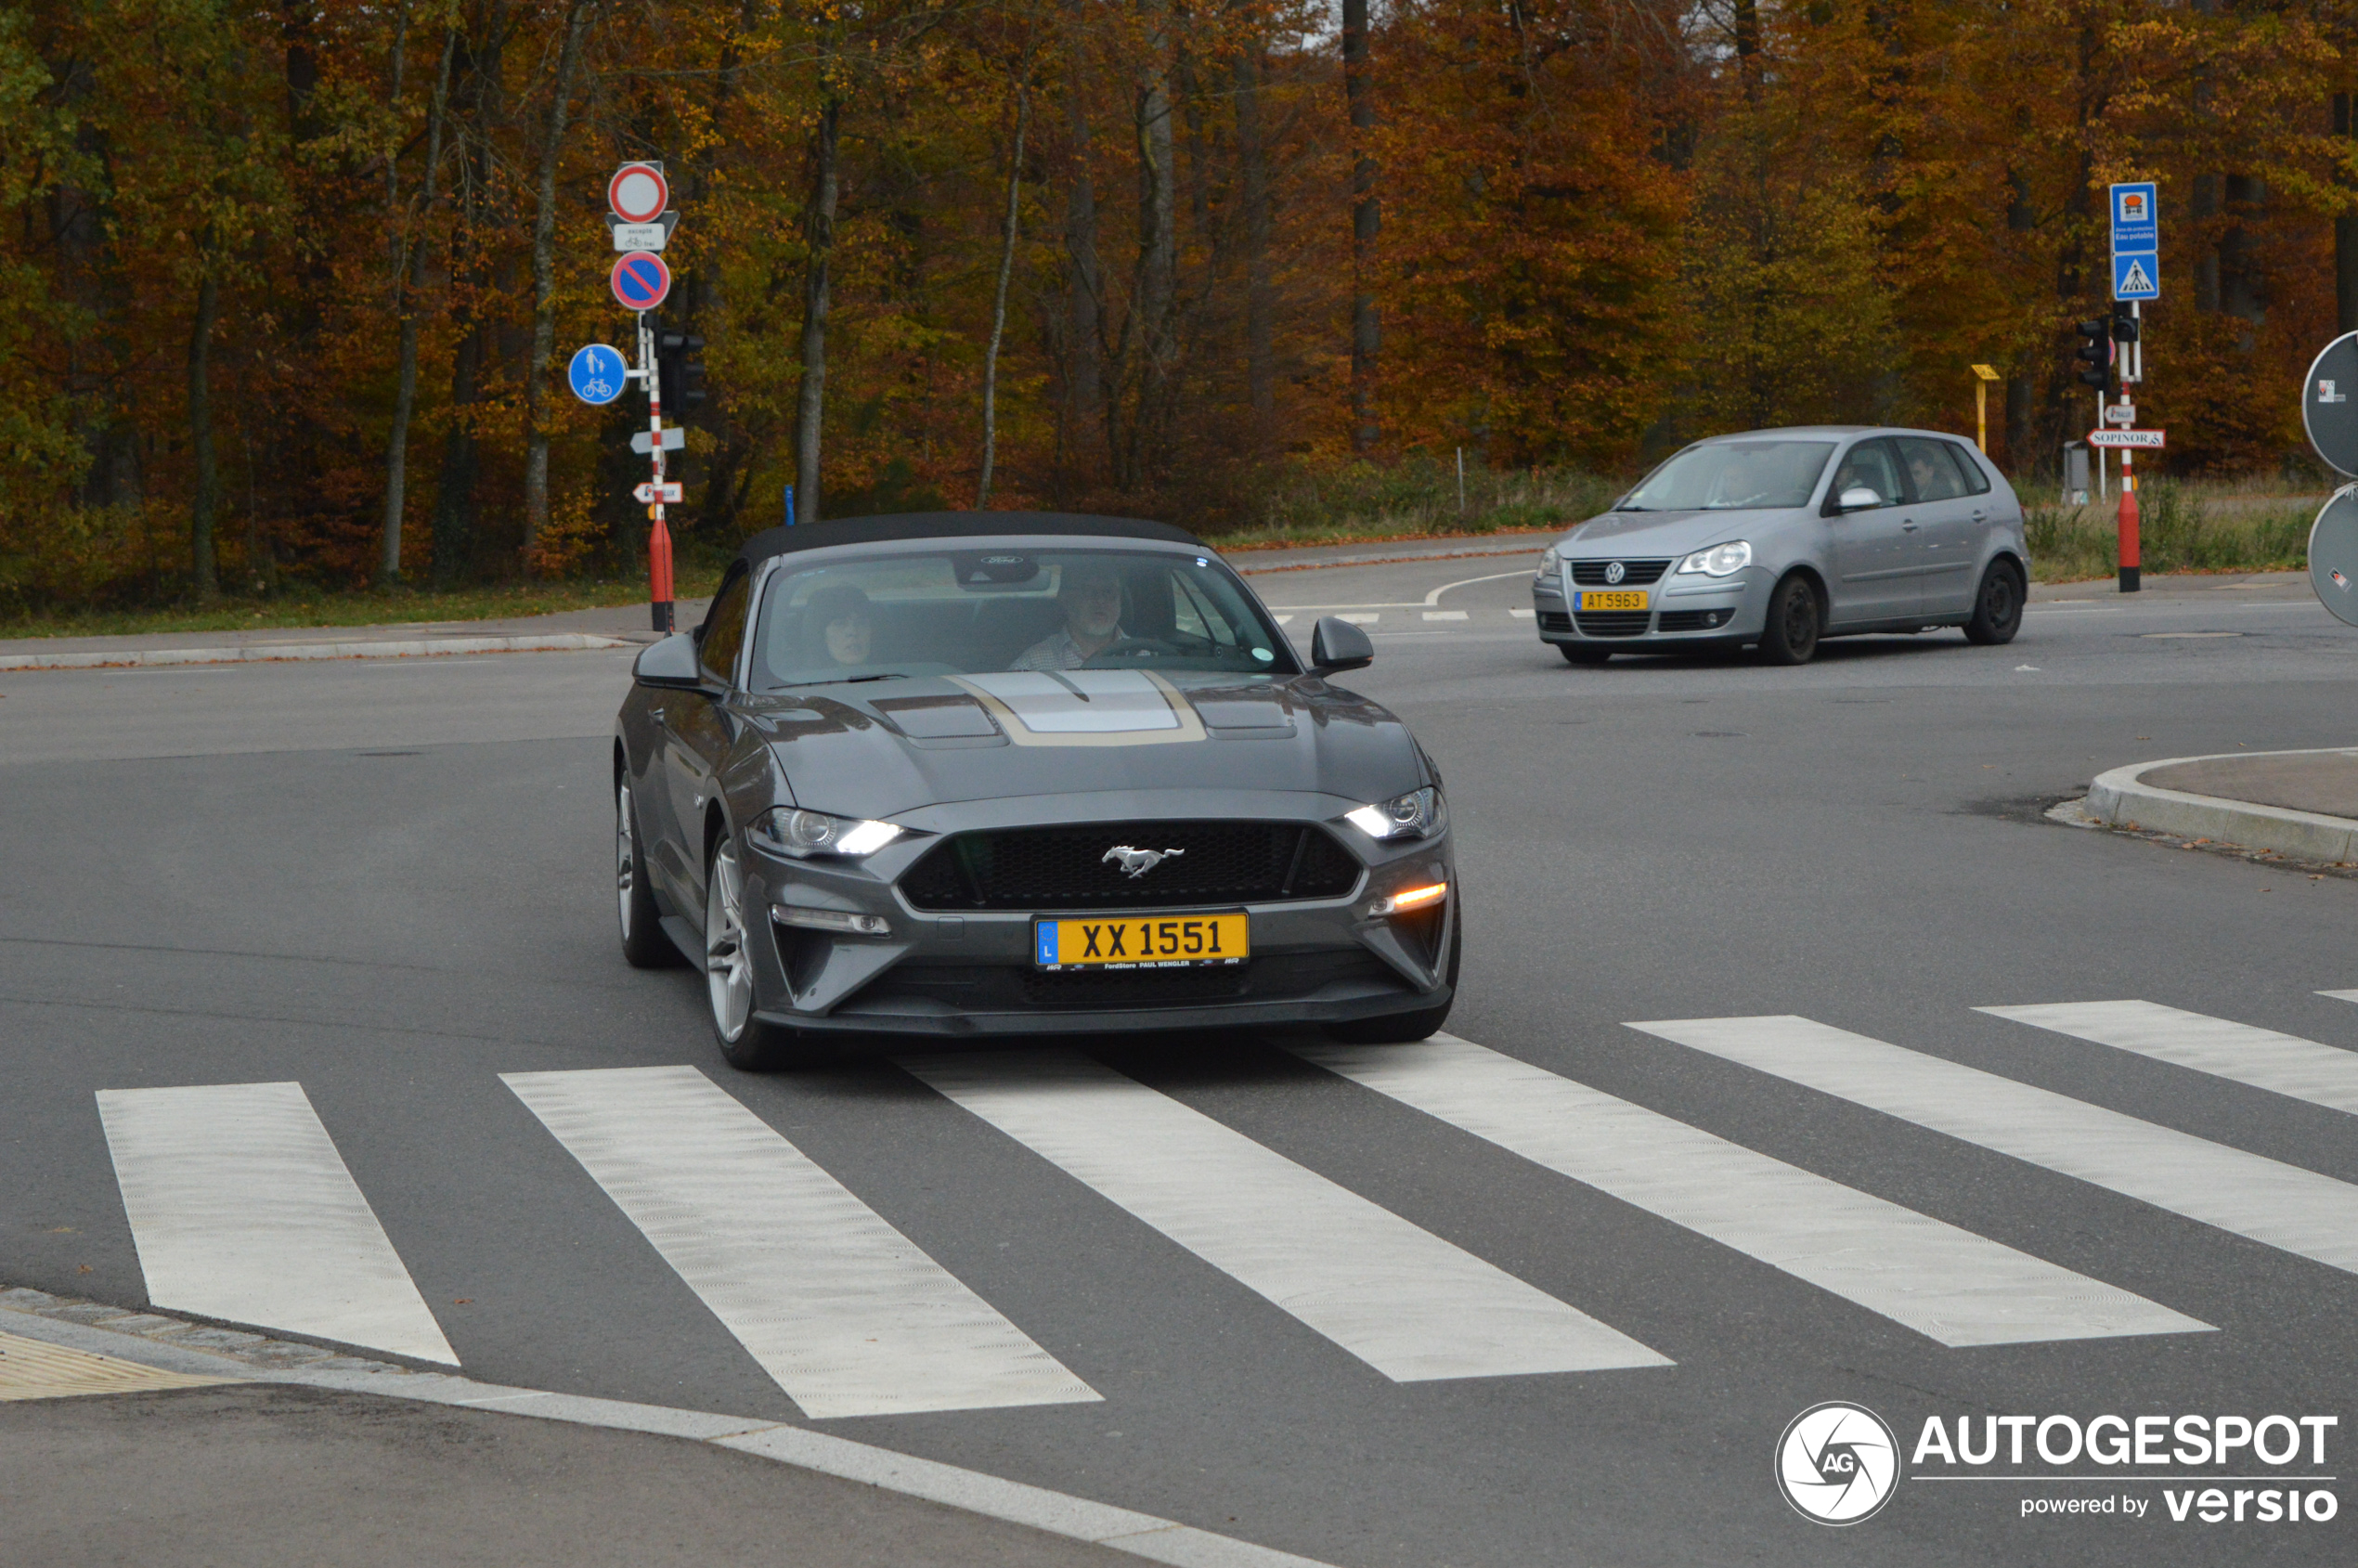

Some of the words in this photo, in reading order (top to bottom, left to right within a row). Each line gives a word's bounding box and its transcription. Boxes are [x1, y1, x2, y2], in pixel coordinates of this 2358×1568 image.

[2130, 232, 2155, 240] potable
[2093, 433, 2148, 443] SOPINOR
[1587, 594, 1603, 607] AT
[1606, 593, 1640, 607] 5963
[1082, 924, 1126, 957] XX
[1140, 921, 1222, 955] 1551
[1044, 945, 1052, 957] L
